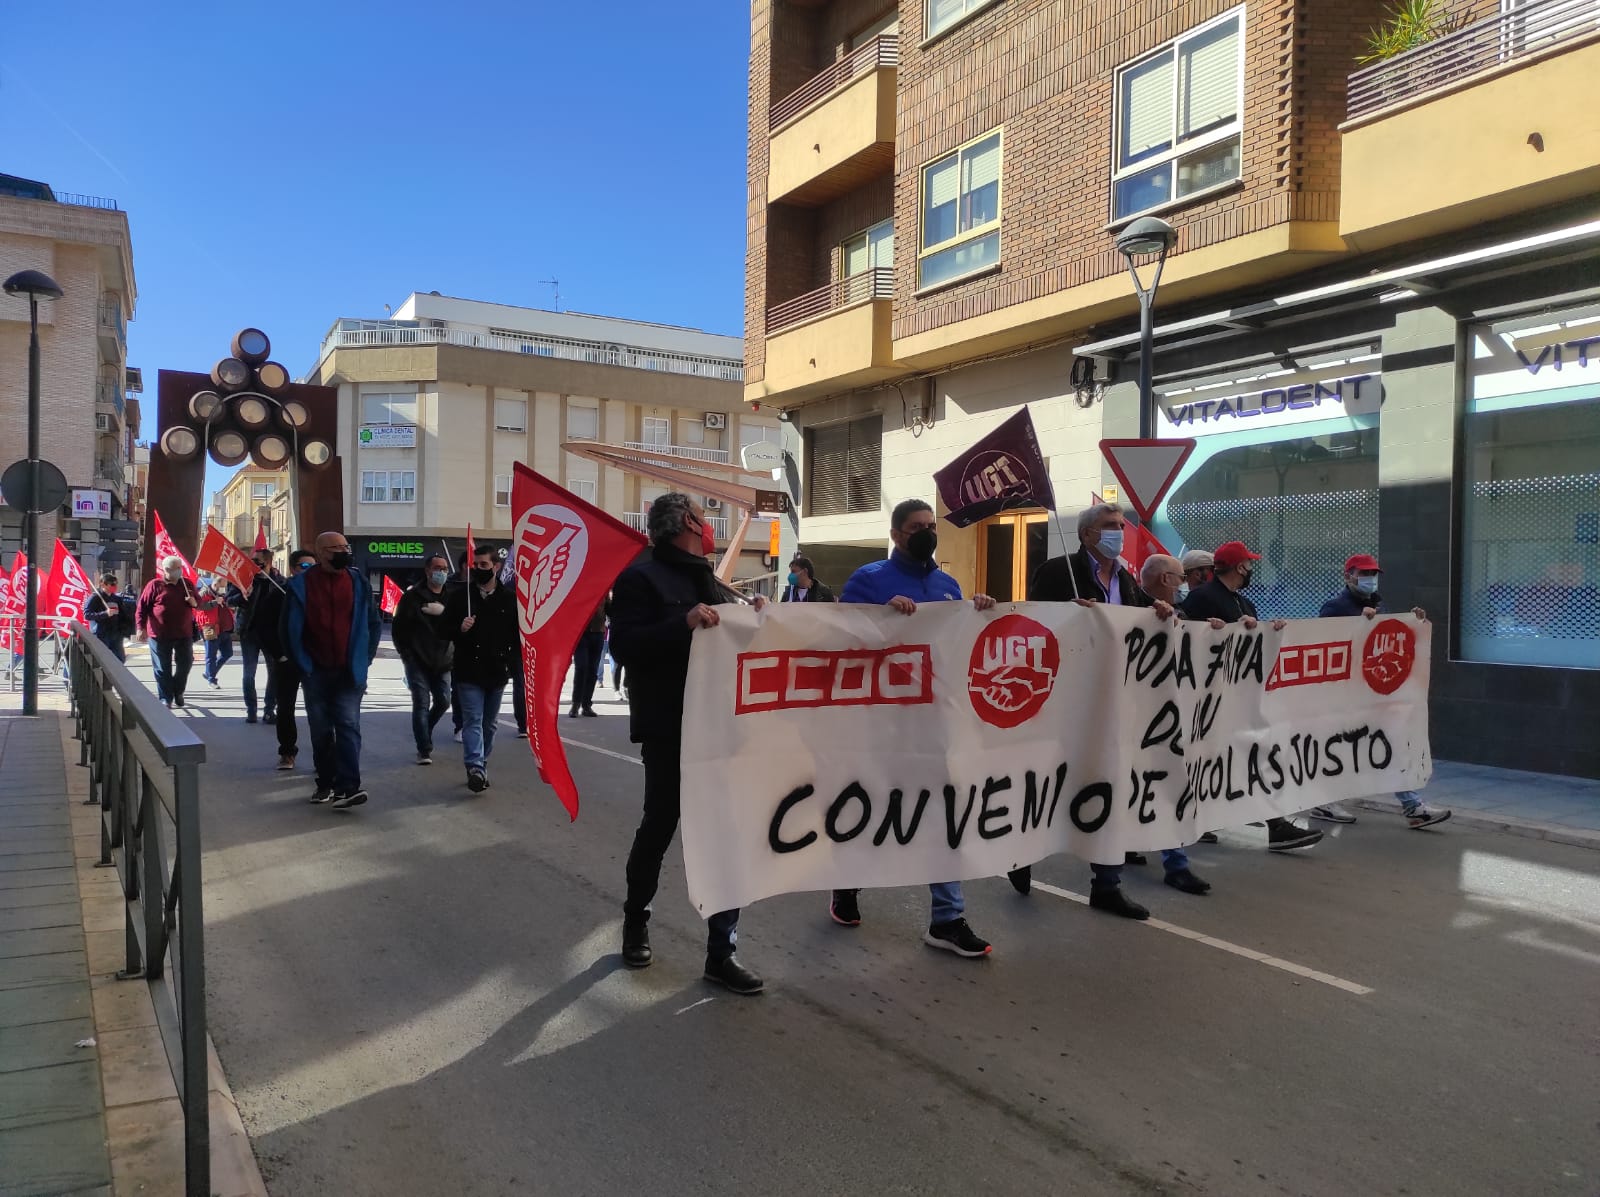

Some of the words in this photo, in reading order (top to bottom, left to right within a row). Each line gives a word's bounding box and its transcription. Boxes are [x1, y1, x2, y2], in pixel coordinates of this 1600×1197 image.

[1167, 375, 1372, 427] VITALDENT
[965, 456, 1020, 504] UGT
[368, 542, 424, 554] ORENES
[983, 635, 1047, 669] UGT
[1372, 632, 1406, 655] UGT
[740, 651, 924, 705] CCOO
[768, 762, 1113, 854] CONVENIO
[1290, 726, 1392, 786] JUSTO
